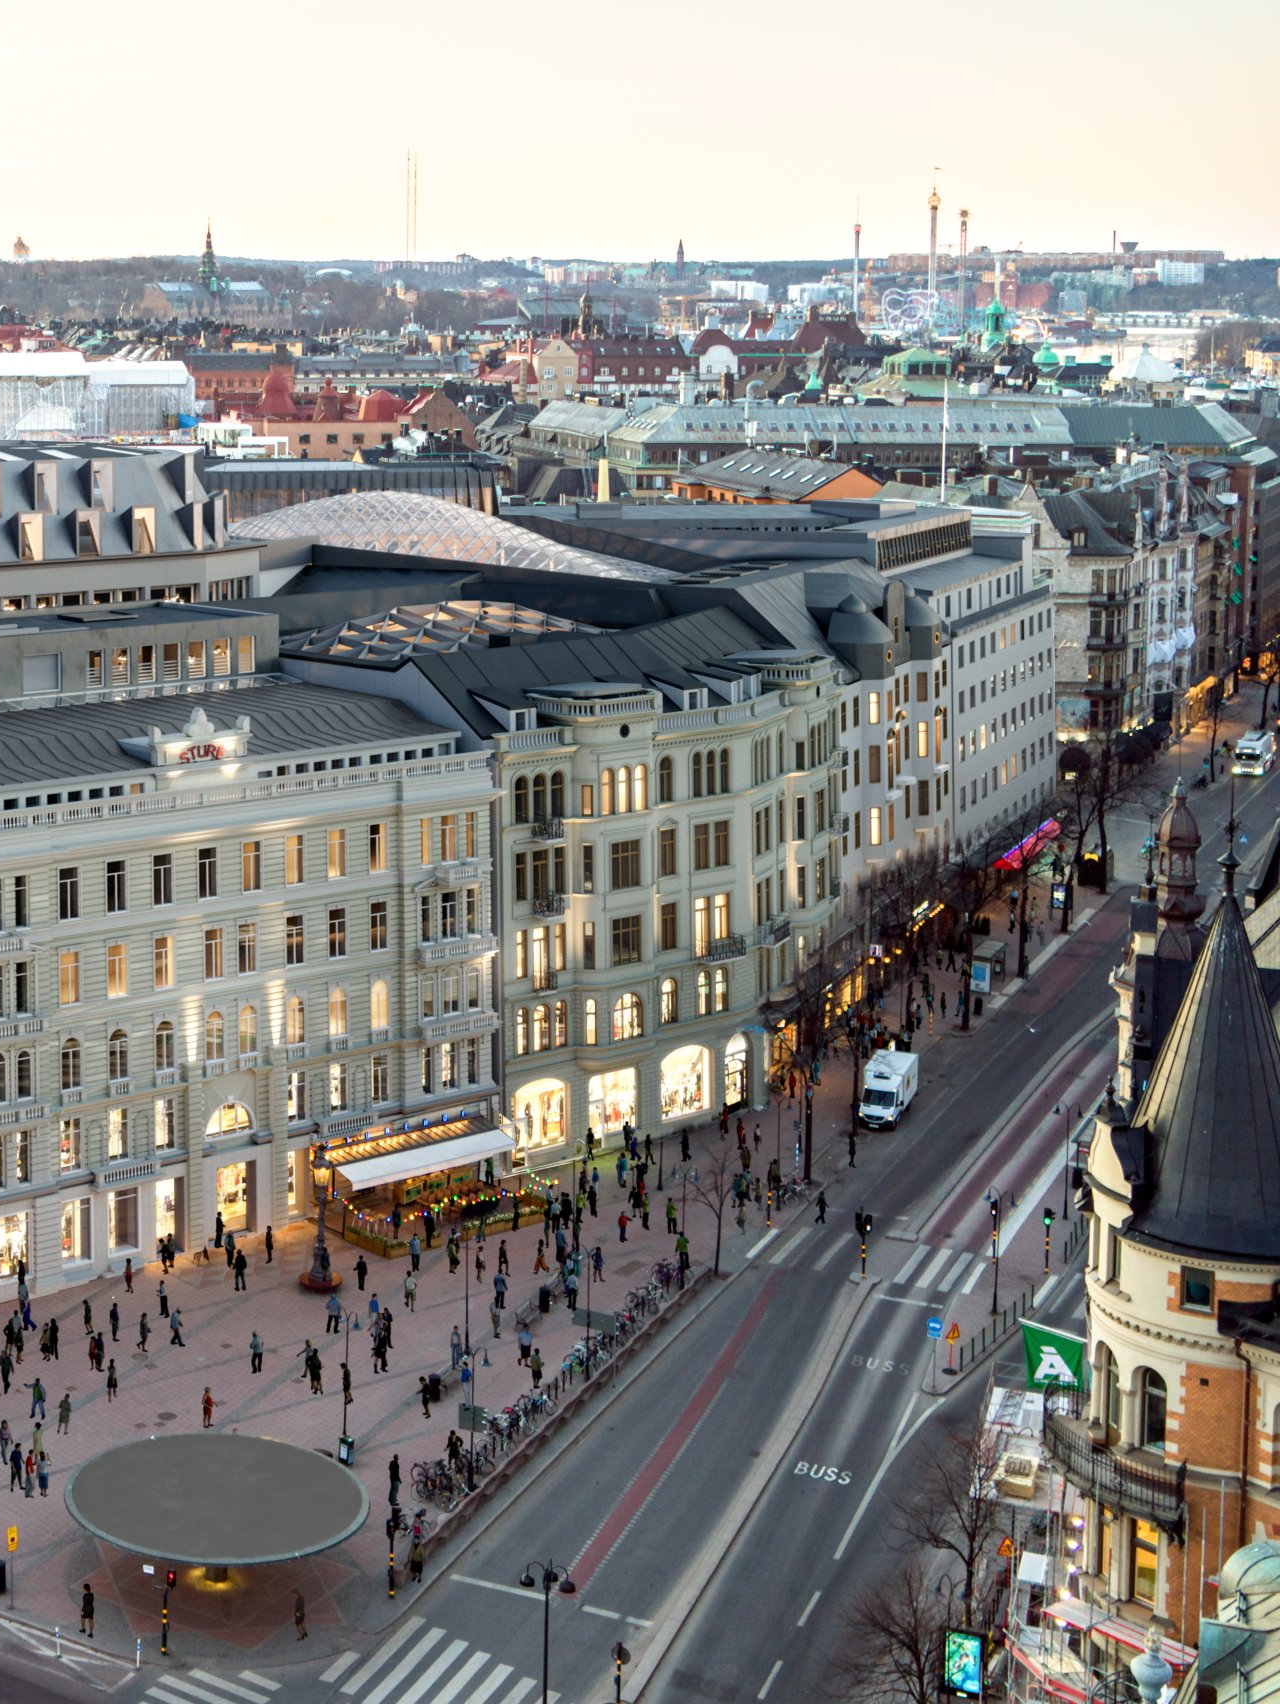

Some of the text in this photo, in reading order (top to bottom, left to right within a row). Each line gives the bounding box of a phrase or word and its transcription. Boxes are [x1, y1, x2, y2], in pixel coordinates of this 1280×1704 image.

[325, 1110, 467, 1149] STUREHOF
[851, 1355, 910, 1376] BUSS
[793, 1461, 853, 1485] BUSS
